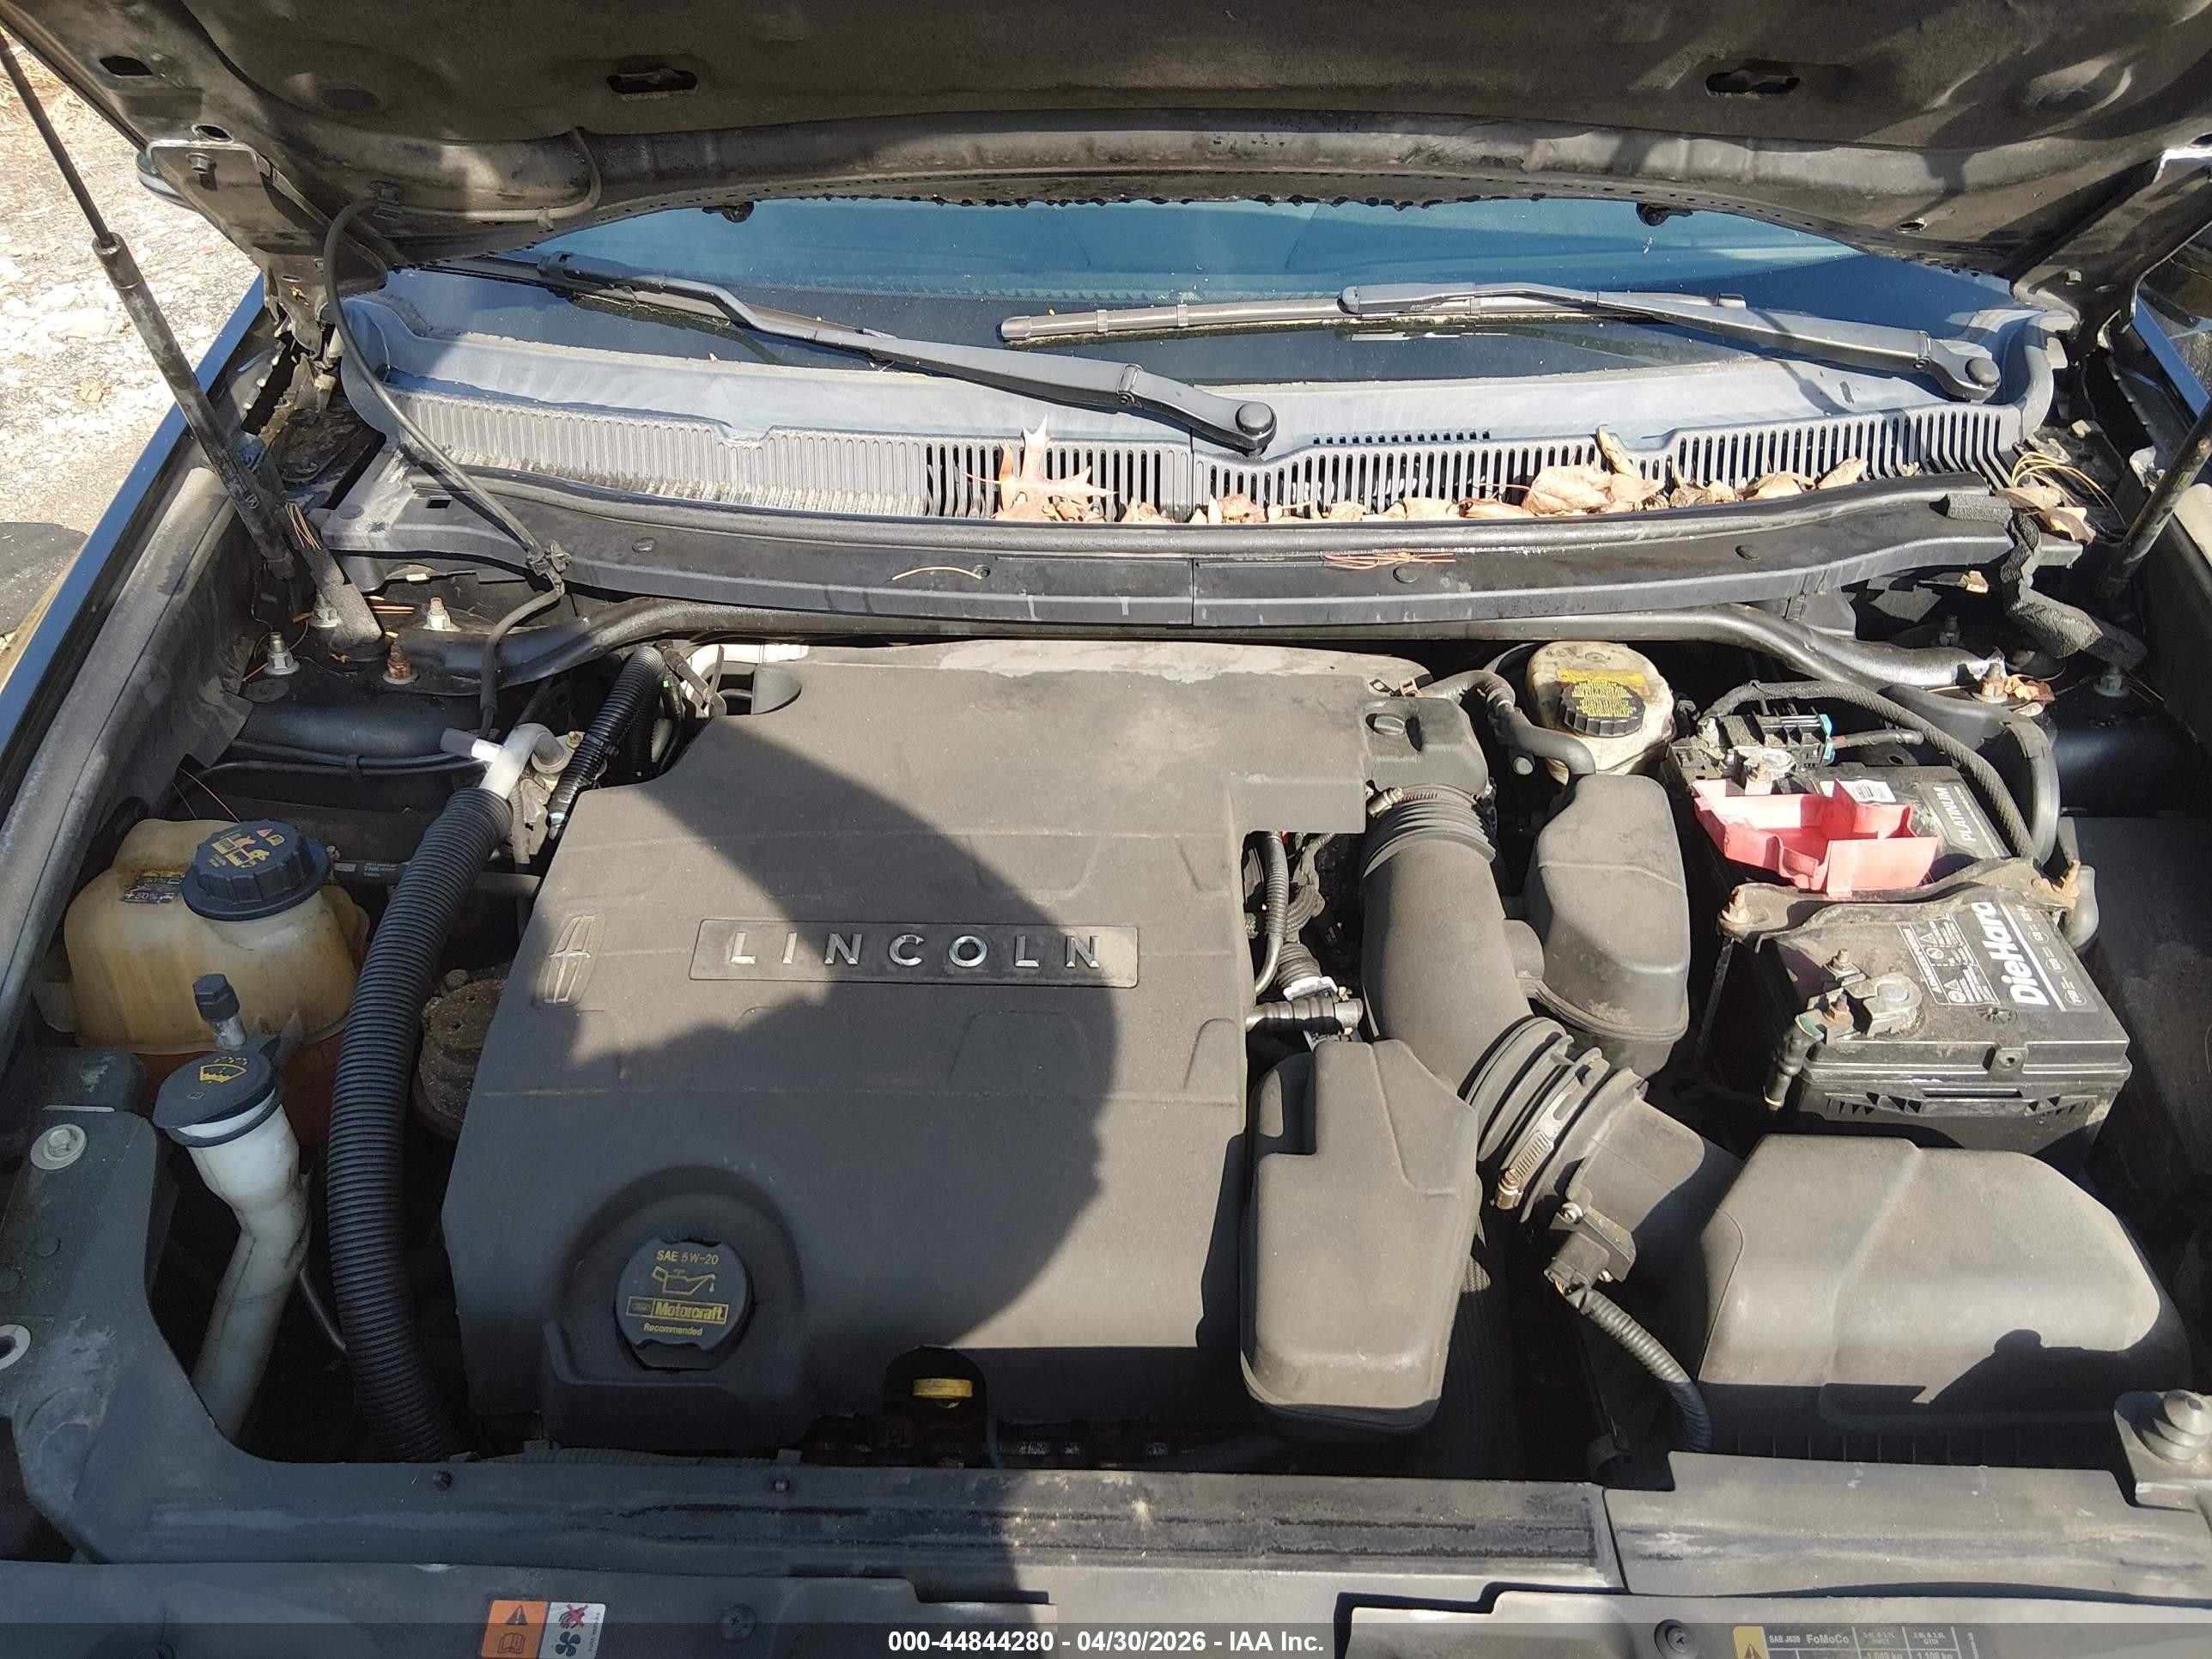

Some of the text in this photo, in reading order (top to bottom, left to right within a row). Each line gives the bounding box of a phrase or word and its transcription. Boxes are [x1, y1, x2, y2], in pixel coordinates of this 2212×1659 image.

[1934, 787, 1977, 842] PLATINUM
[730, 932, 1100, 968] LINCOLN
[1970, 902, 2049, 1006] DieHard
[656, 1250, 719, 1265] SAE 5W-20
[644, 1322, 703, 1336] Recommended
[1769, 1634, 1784, 1644] SAE
[1806, 1633, 1850, 1644] FoMoCo
